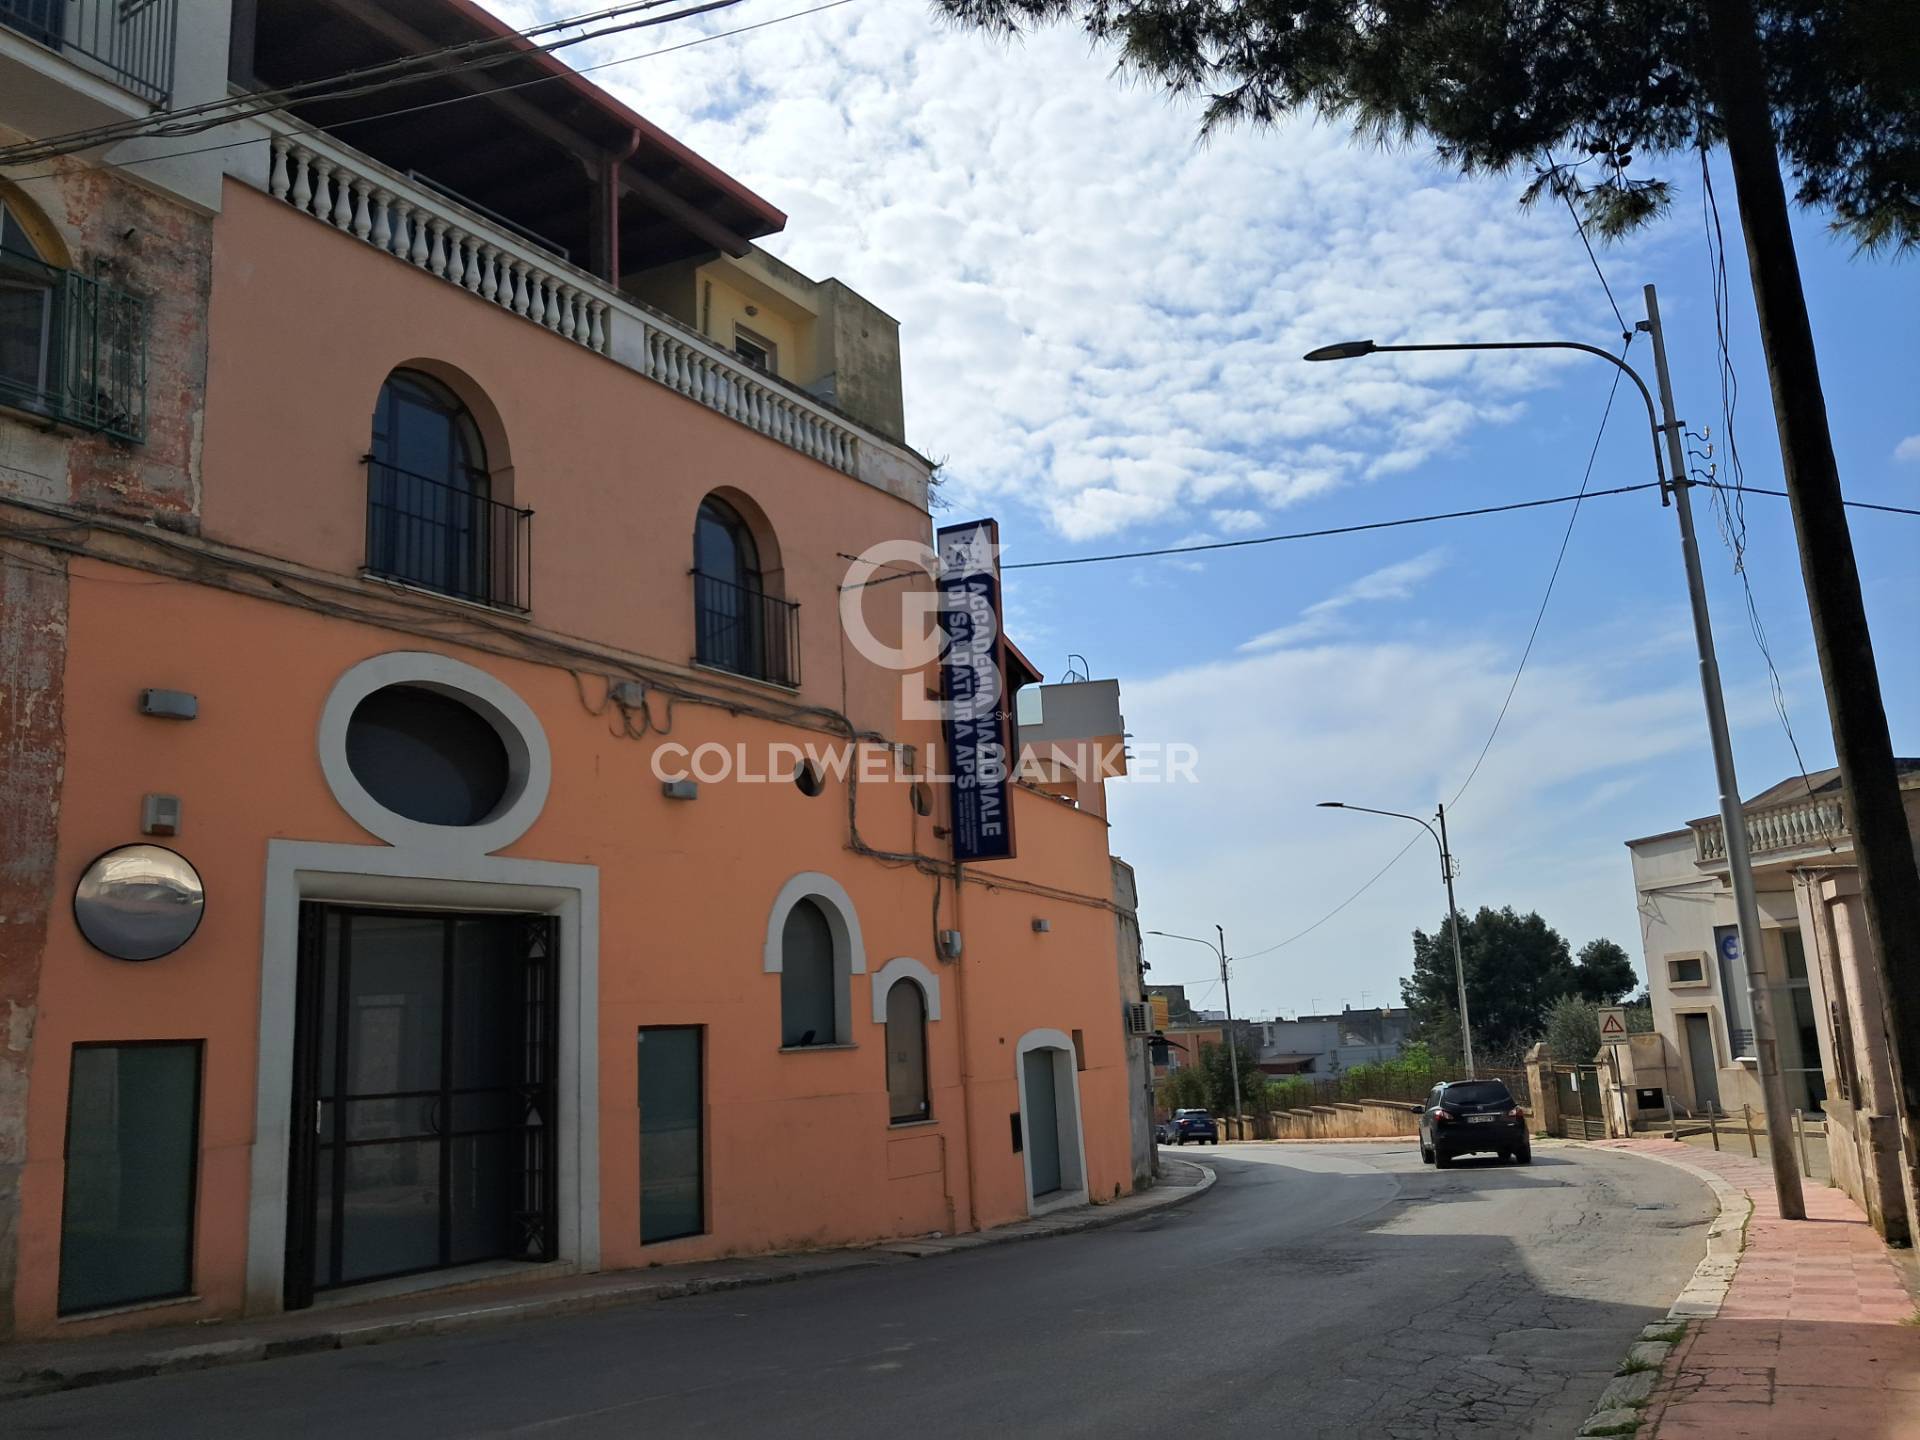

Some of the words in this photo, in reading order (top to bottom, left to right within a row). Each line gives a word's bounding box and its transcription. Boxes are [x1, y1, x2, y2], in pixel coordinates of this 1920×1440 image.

[948, 585, 967, 606] DI
[969, 582, 994, 707] ACCADEMIA
[950, 612, 974, 739] SALDATURA
[956, 744, 976, 789] APS
[977, 710, 1001, 836] NAZIONALE
